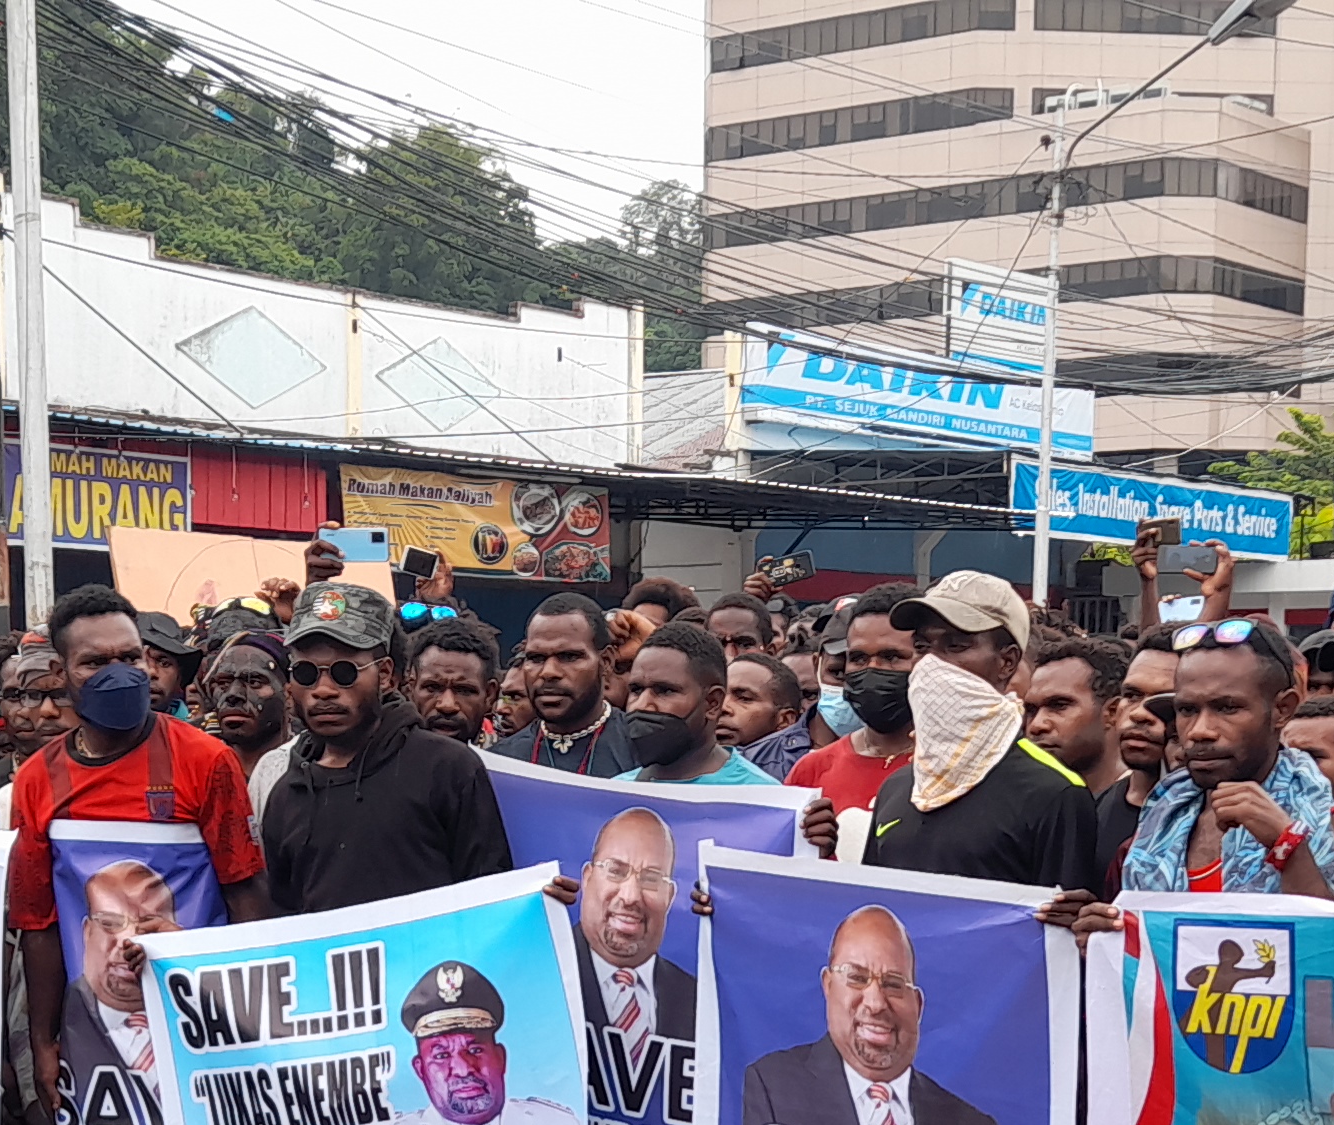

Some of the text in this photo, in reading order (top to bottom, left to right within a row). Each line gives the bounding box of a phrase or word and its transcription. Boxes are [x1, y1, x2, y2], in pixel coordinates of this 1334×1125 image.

[802, 352, 1005, 409] DAIKIN
[835, 401, 879, 416] SEJUK
[885, 408, 944, 426] MANDIRI
[951, 418, 1028, 439] NUSANTARA
[51, 452, 173, 483] MAH MAKAN
[347, 478, 395, 496] Rumah
[399, 482, 443, 500] Makan
[1194, 500, 1222, 531] Parts
[1225, 505, 1234, 531] &
[1238, 508, 1277, 538] Service
[1186, 964, 1286, 1073] knpi
[587, 1028, 695, 1123] AVE
